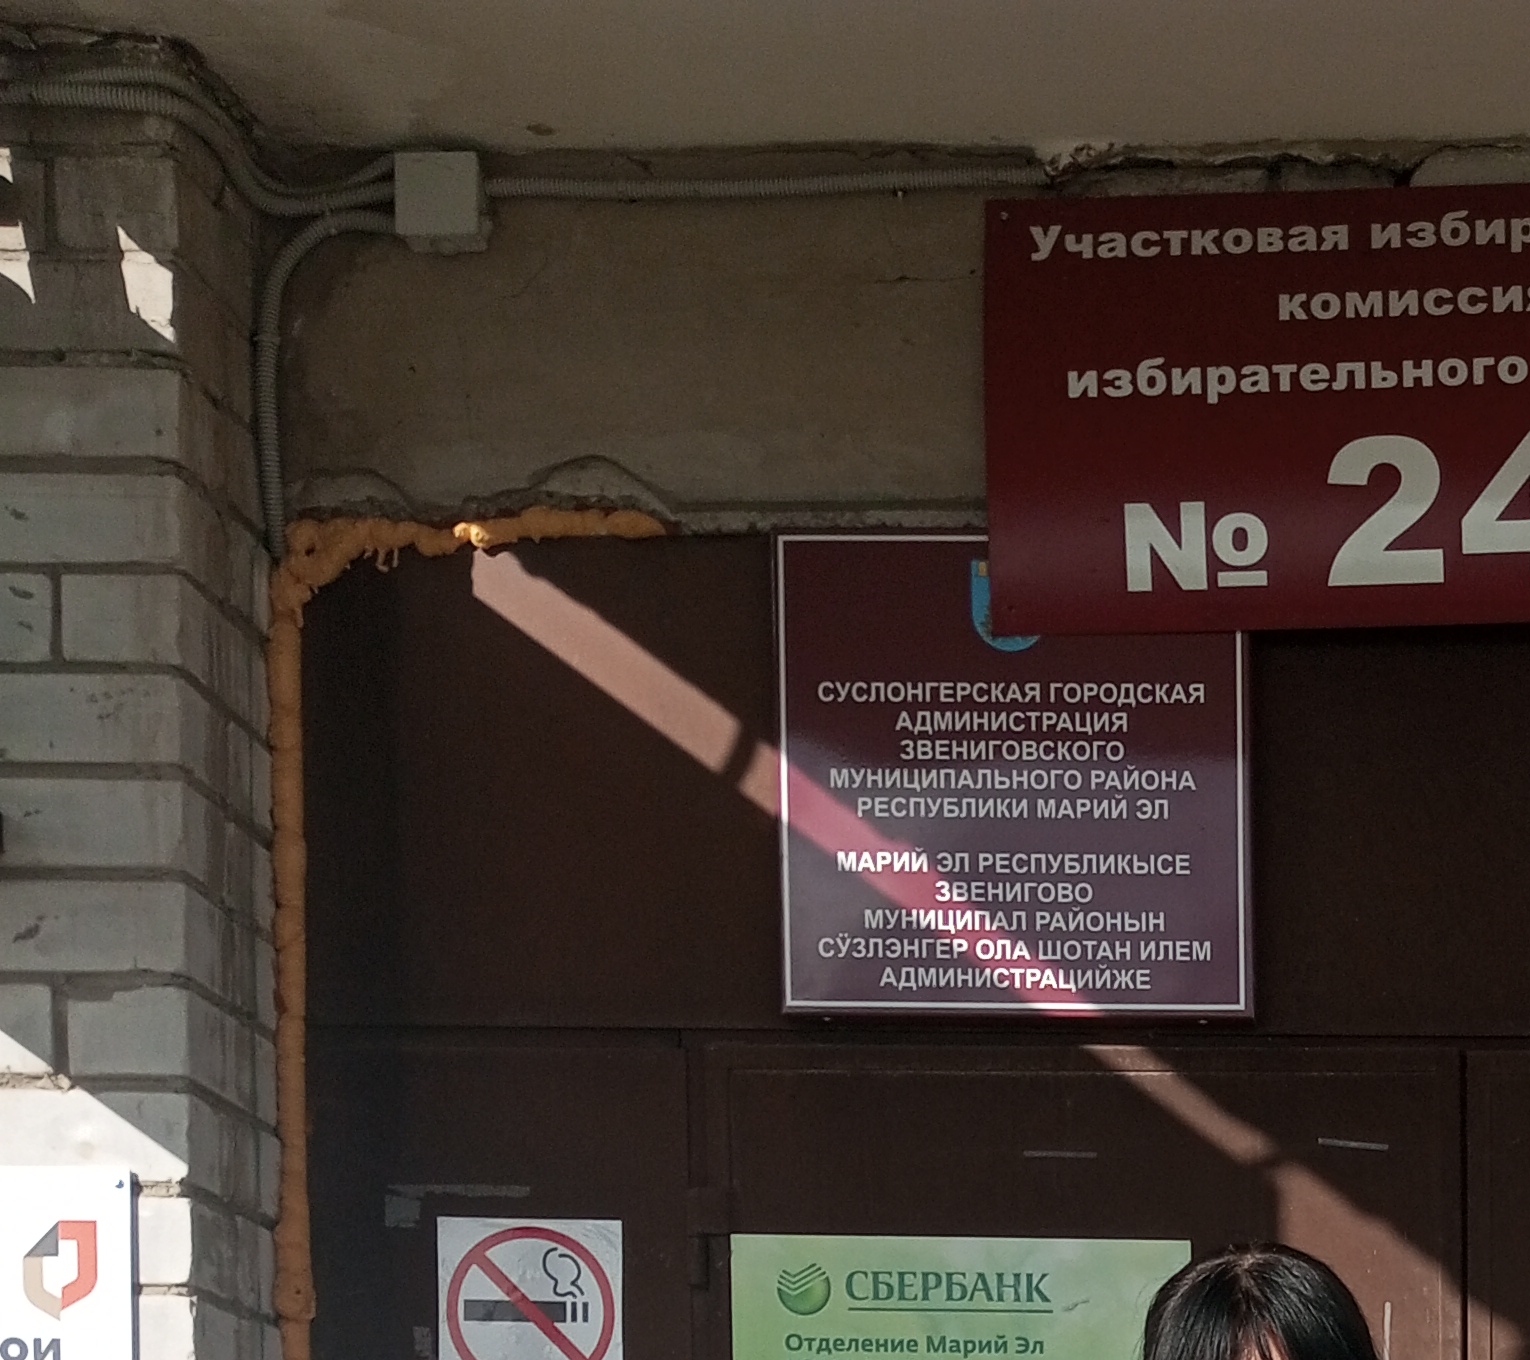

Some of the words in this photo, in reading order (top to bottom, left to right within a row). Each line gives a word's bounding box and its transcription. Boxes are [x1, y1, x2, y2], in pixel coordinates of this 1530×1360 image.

[1030, 220, 1350, 261] Участковая
[1066, 347, 1528, 404] избирательного
[1124, 501, 1269, 593] №
[818, 682, 1040, 703] СУСЛОНГЕРСКАЯ
[1050, 683, 1204, 706] ГОРОДСКАЯ
[895, 712, 1127, 735] АДМИНИСТРАЦИЯ
[900, 741, 1124, 760] ЗВЕНИГОВСКОГО
[830, 769, 1082, 792] МУНИЦИПАЛЬНОГО
[1091, 764, 1195, 791] РАЙОНА
[858, 798, 1028, 818] РЕСПУБЛИКИ
[1037, 795, 1127, 819] МАРИЙ
[1135, 800, 1168, 819] ЭЛ
[837, 848, 927, 872] МАРИЙ
[936, 853, 969, 873] ЭЛ
[979, 854, 1190, 875] РЕСПУБЛИКЫСЕ
[936, 881, 1092, 902] ЗВЕНИГОВО
[865, 910, 1027, 934] МУНИЦИПАЛ
[1036, 906, 1164, 932] РАЙОНЫН
[976, 940, 1031, 960] ОЛА
[1038, 941, 1131, 960] ШОТАН
[1140, 941, 1211, 961] ИЛЕМ
[880, 964, 1150, 991] АДМИНИСТРАЦИЙЖЕ
[845, 1270, 1051, 1302] СБЕРБАНК
[785, 1334, 918, 1354] Отделение
[927, 1335, 1008, 1358] Марий
[1015, 1337, 1044, 1354] Эл
